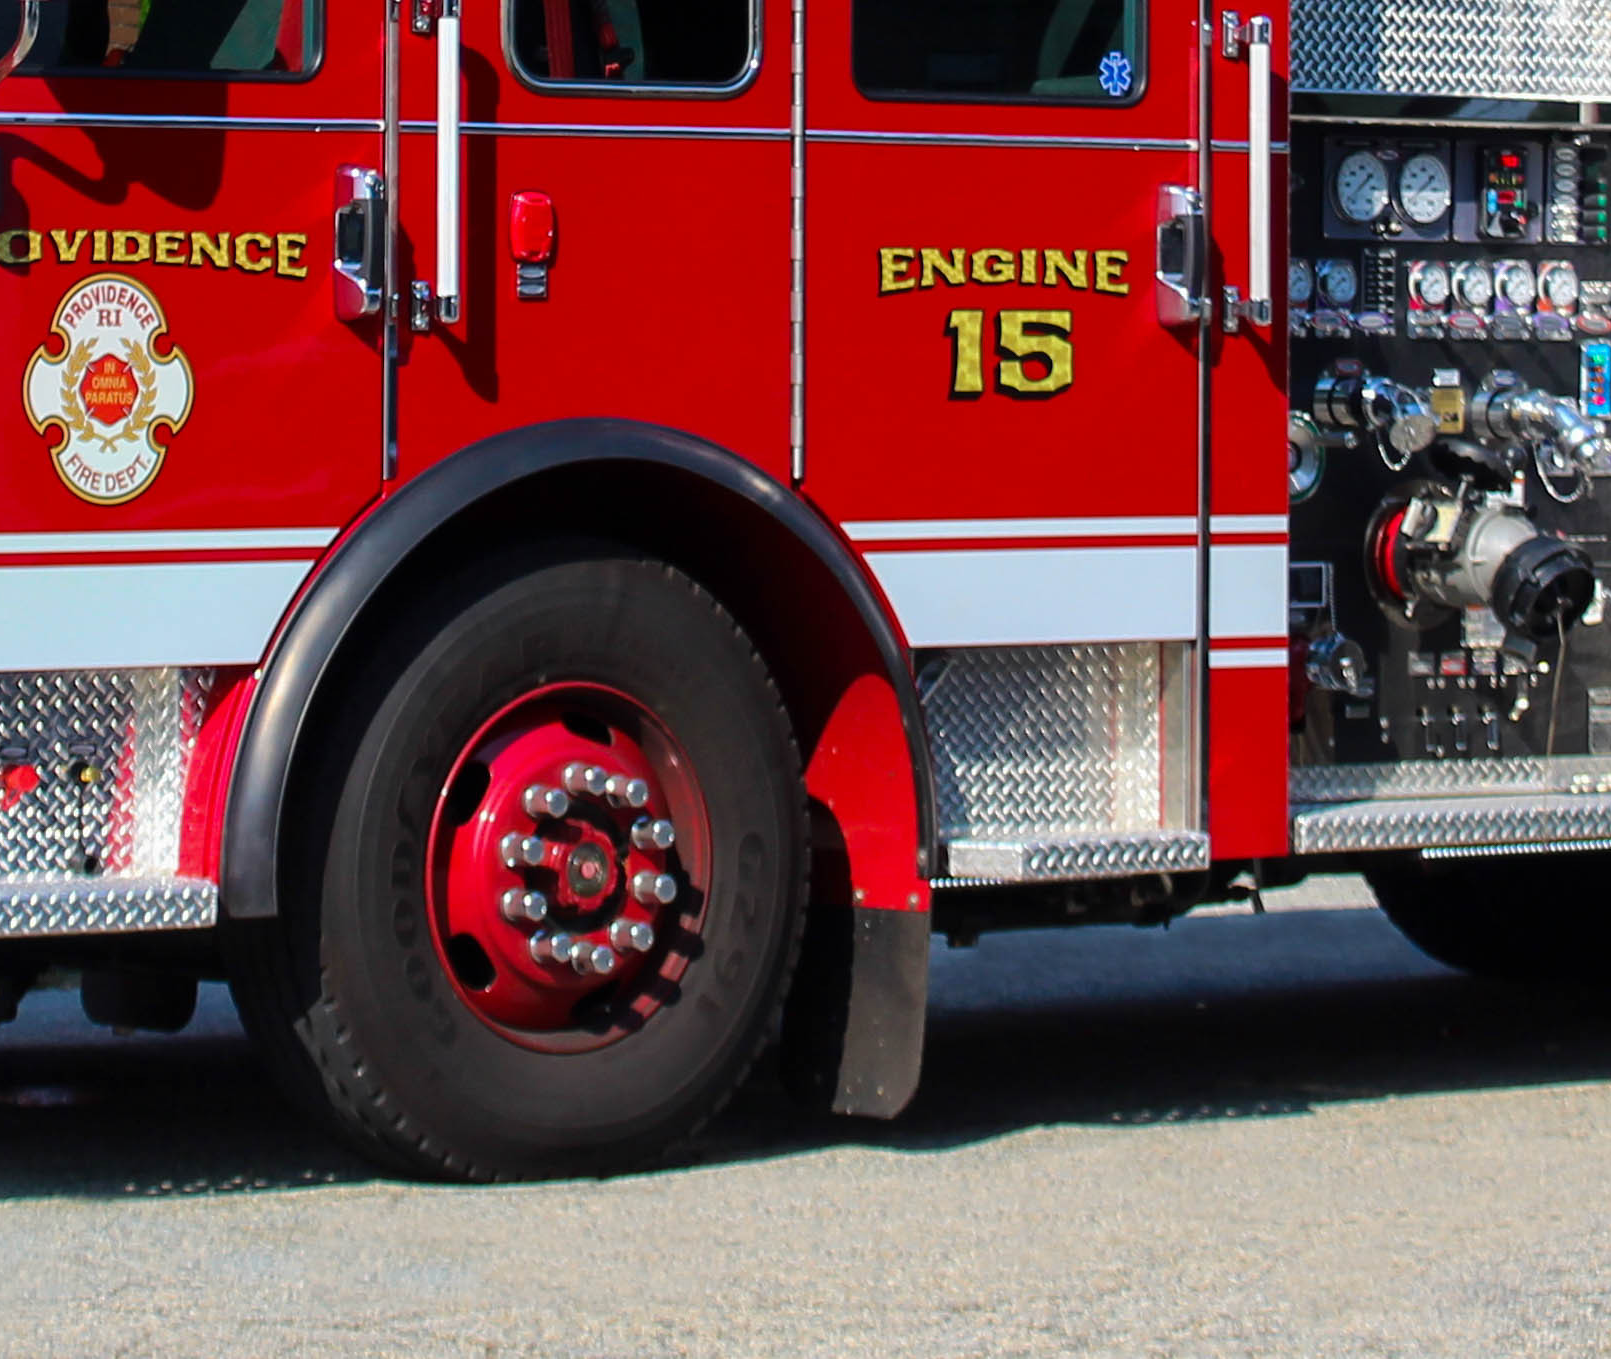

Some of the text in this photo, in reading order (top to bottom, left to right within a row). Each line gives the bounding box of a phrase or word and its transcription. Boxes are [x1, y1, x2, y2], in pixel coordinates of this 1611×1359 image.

[877, 246, 1131, 298] ENGINE
[63, 285, 156, 329] PROVIDENCE
[104, 363, 116, 374] IN
[946, 309, 1075, 401] 15
[84, 391, 134, 405] PARATUS
[91, 378, 128, 390] OMNIA
[65, 454, 101, 492] FIRE
